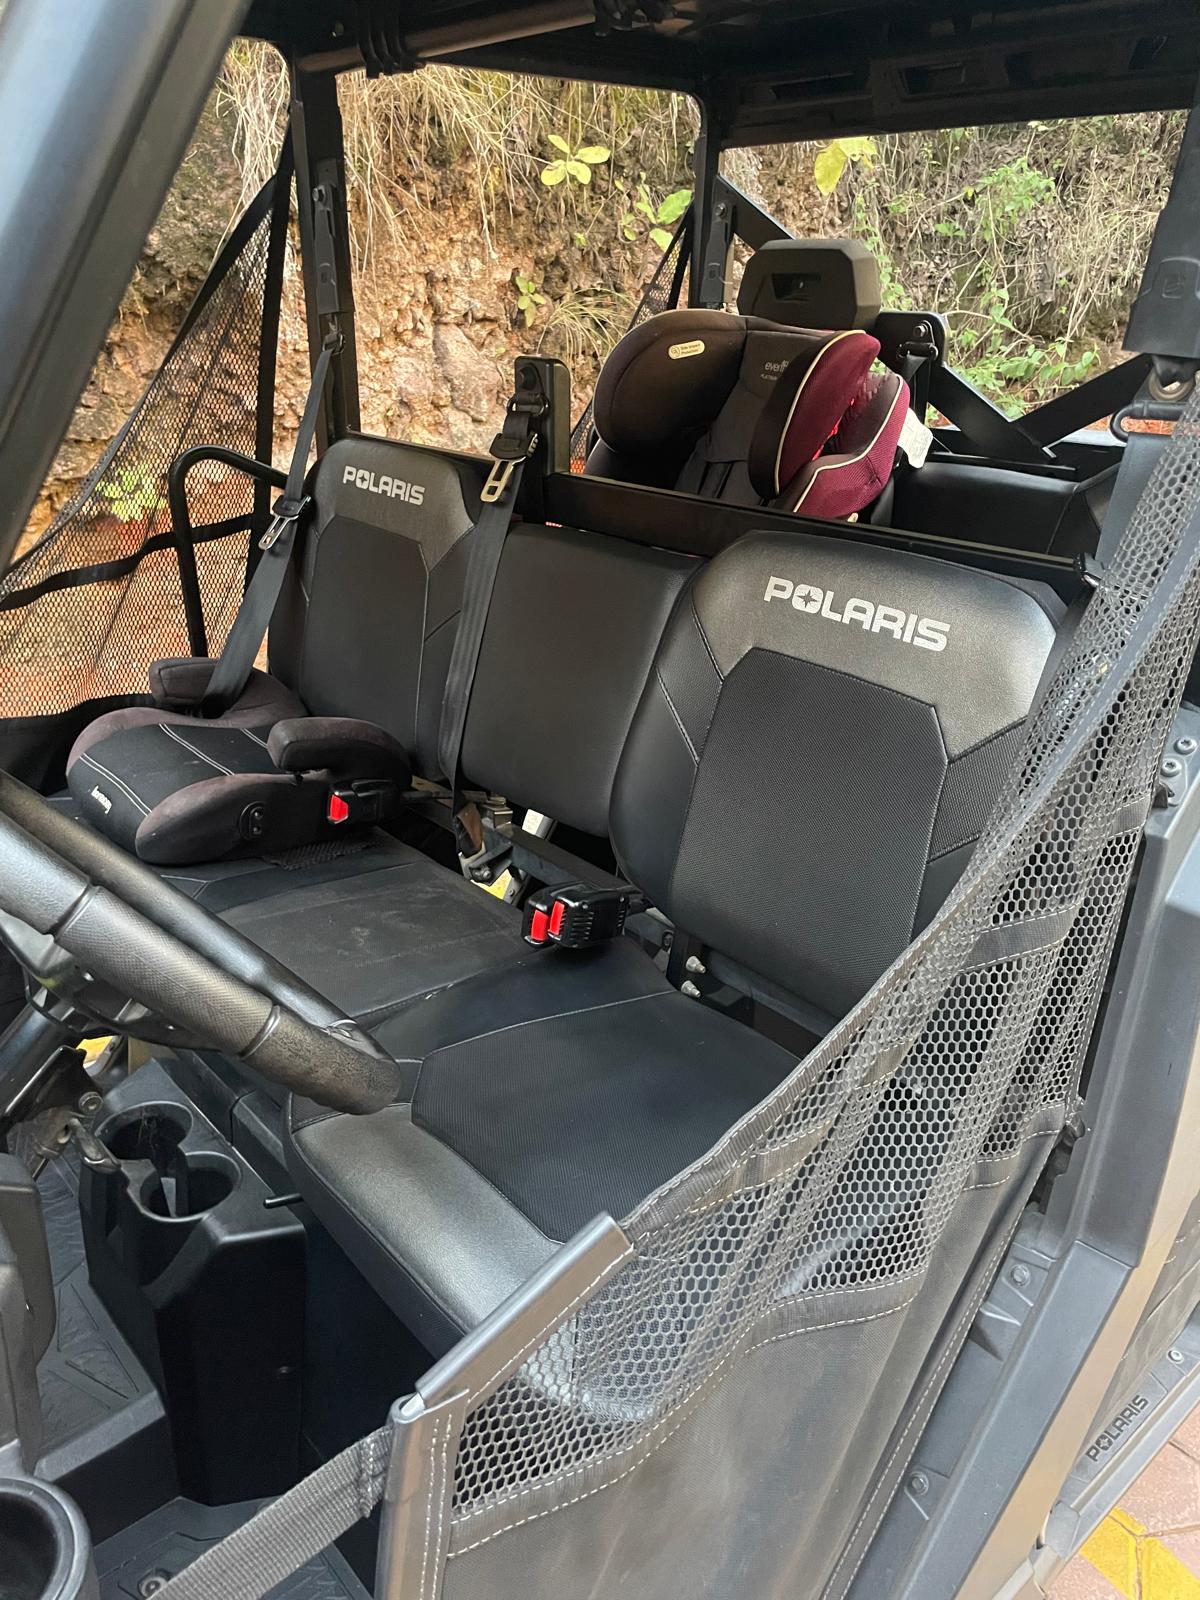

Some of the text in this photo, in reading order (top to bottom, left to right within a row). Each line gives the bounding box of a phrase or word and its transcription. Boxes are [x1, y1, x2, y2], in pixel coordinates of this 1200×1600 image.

[343, 465, 425, 505] POLARIS
[763, 575, 951, 651] POLARIS
[1085, 1394, 1149, 1462] POLARIS
